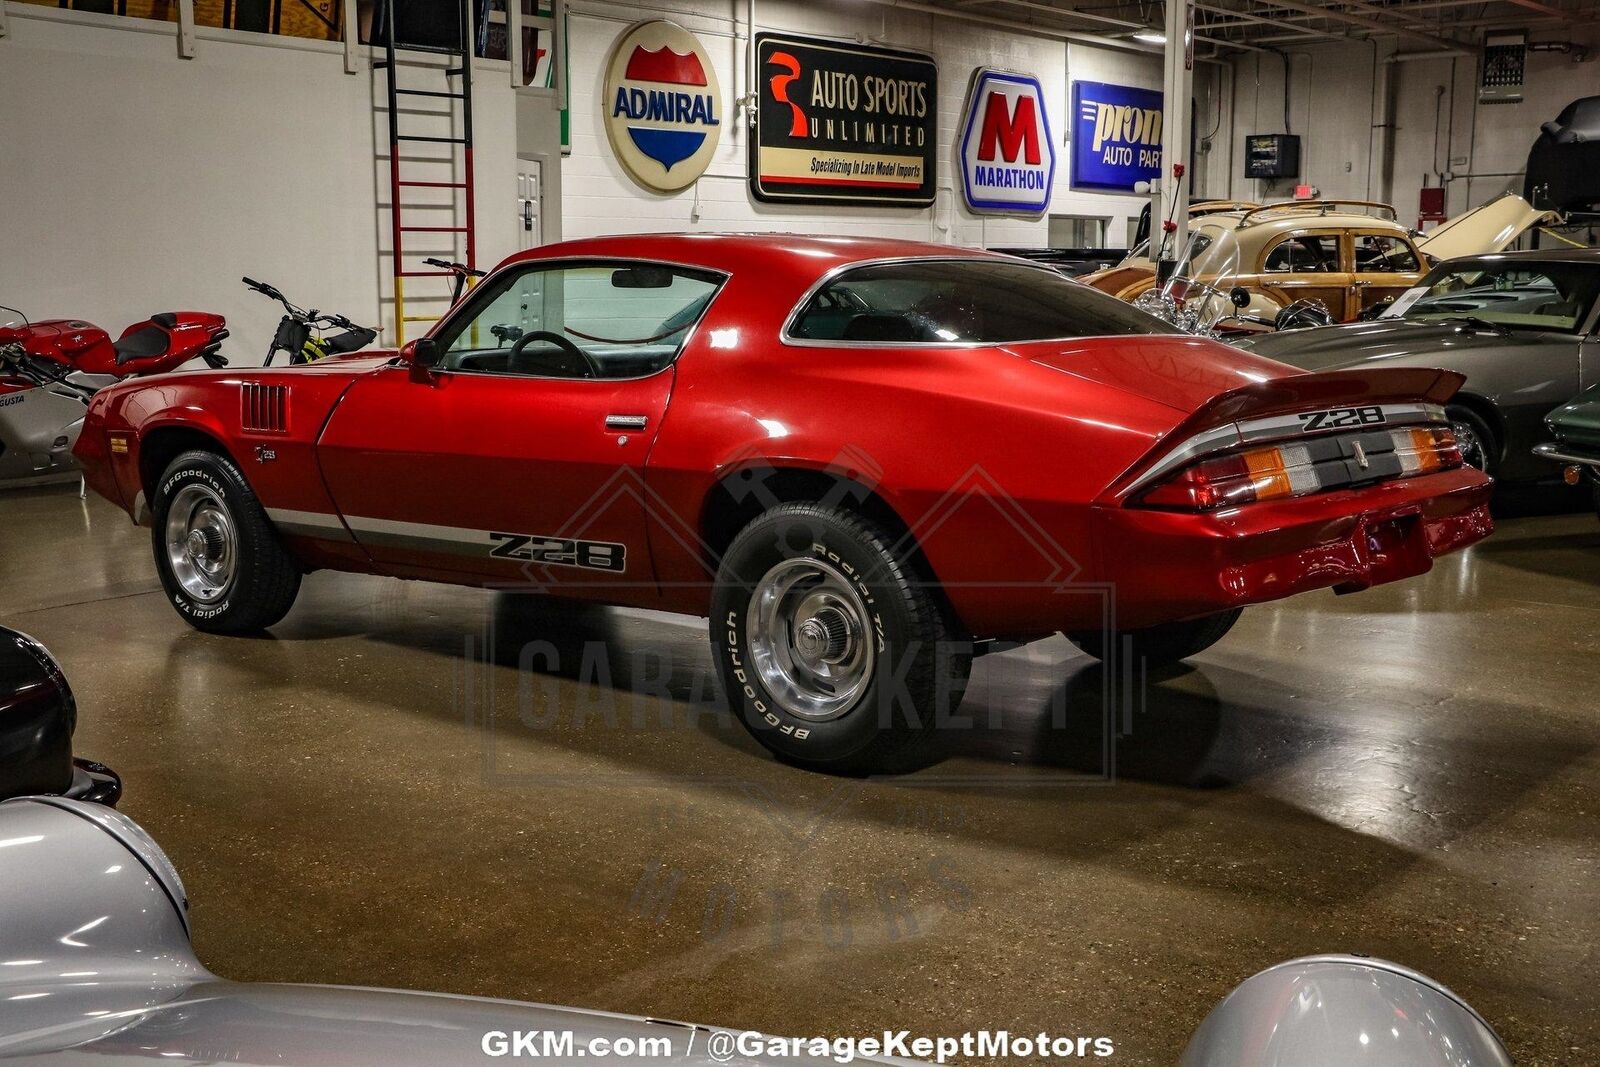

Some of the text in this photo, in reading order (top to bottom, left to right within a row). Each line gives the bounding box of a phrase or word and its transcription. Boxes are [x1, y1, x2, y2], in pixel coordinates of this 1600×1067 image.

[613, 86, 720, 125] ADMIRAL
[811, 69, 927, 118] AUTO SPORTS
[811, 117, 925, 147] UNLIMITED
[977, 91, 1042, 165] M
[811, 157, 921, 178] Specializing In Late Model Imports
[1102, 145, 1133, 167] AUTO
[975, 165, 1045, 190] MARATHON
[1298, 405, 1388, 433] Z28
[163, 470, 227, 499] BFGoodrich
[489, 531, 626, 573] Z28
[175, 594, 230, 619] Radial T/A
[812, 543, 885, 654] Radial T/A
[726, 611, 811, 740] BFGoodrich
